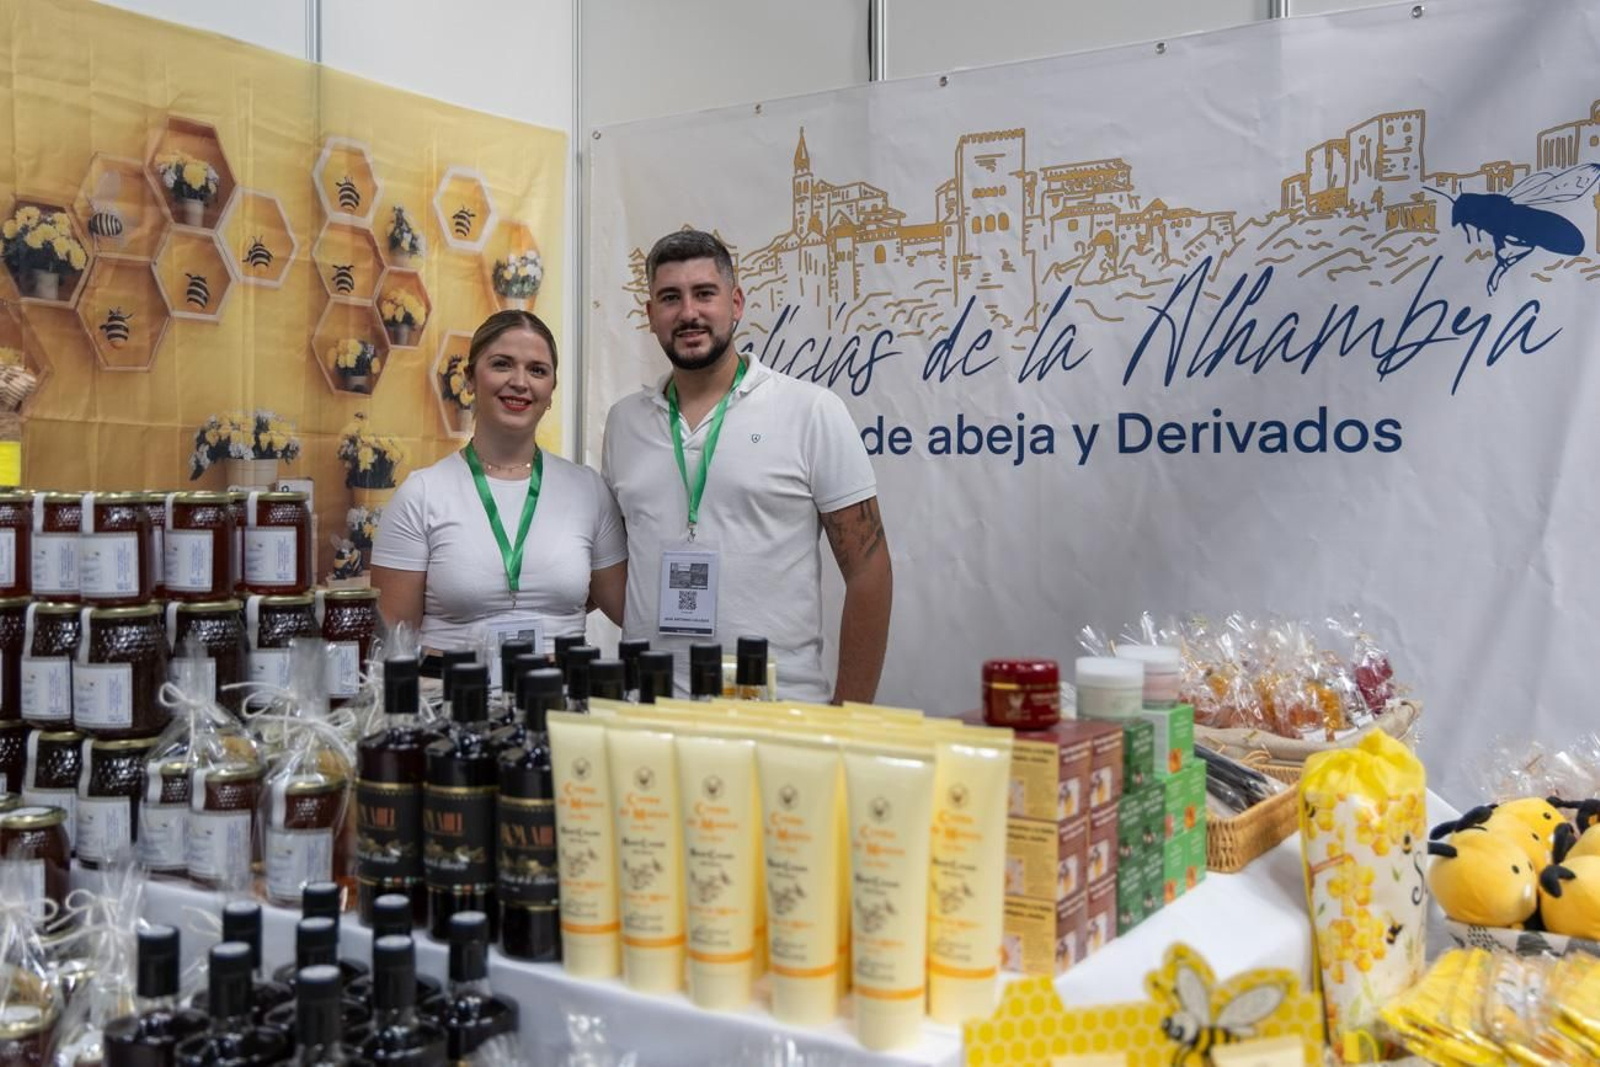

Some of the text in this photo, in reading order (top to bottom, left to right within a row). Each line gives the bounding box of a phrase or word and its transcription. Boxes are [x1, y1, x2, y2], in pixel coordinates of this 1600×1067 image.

[922, 294, 1000, 384] de
[1017, 285, 1094, 384] la
[860, 406, 1402, 466] de abeja y Derivados
